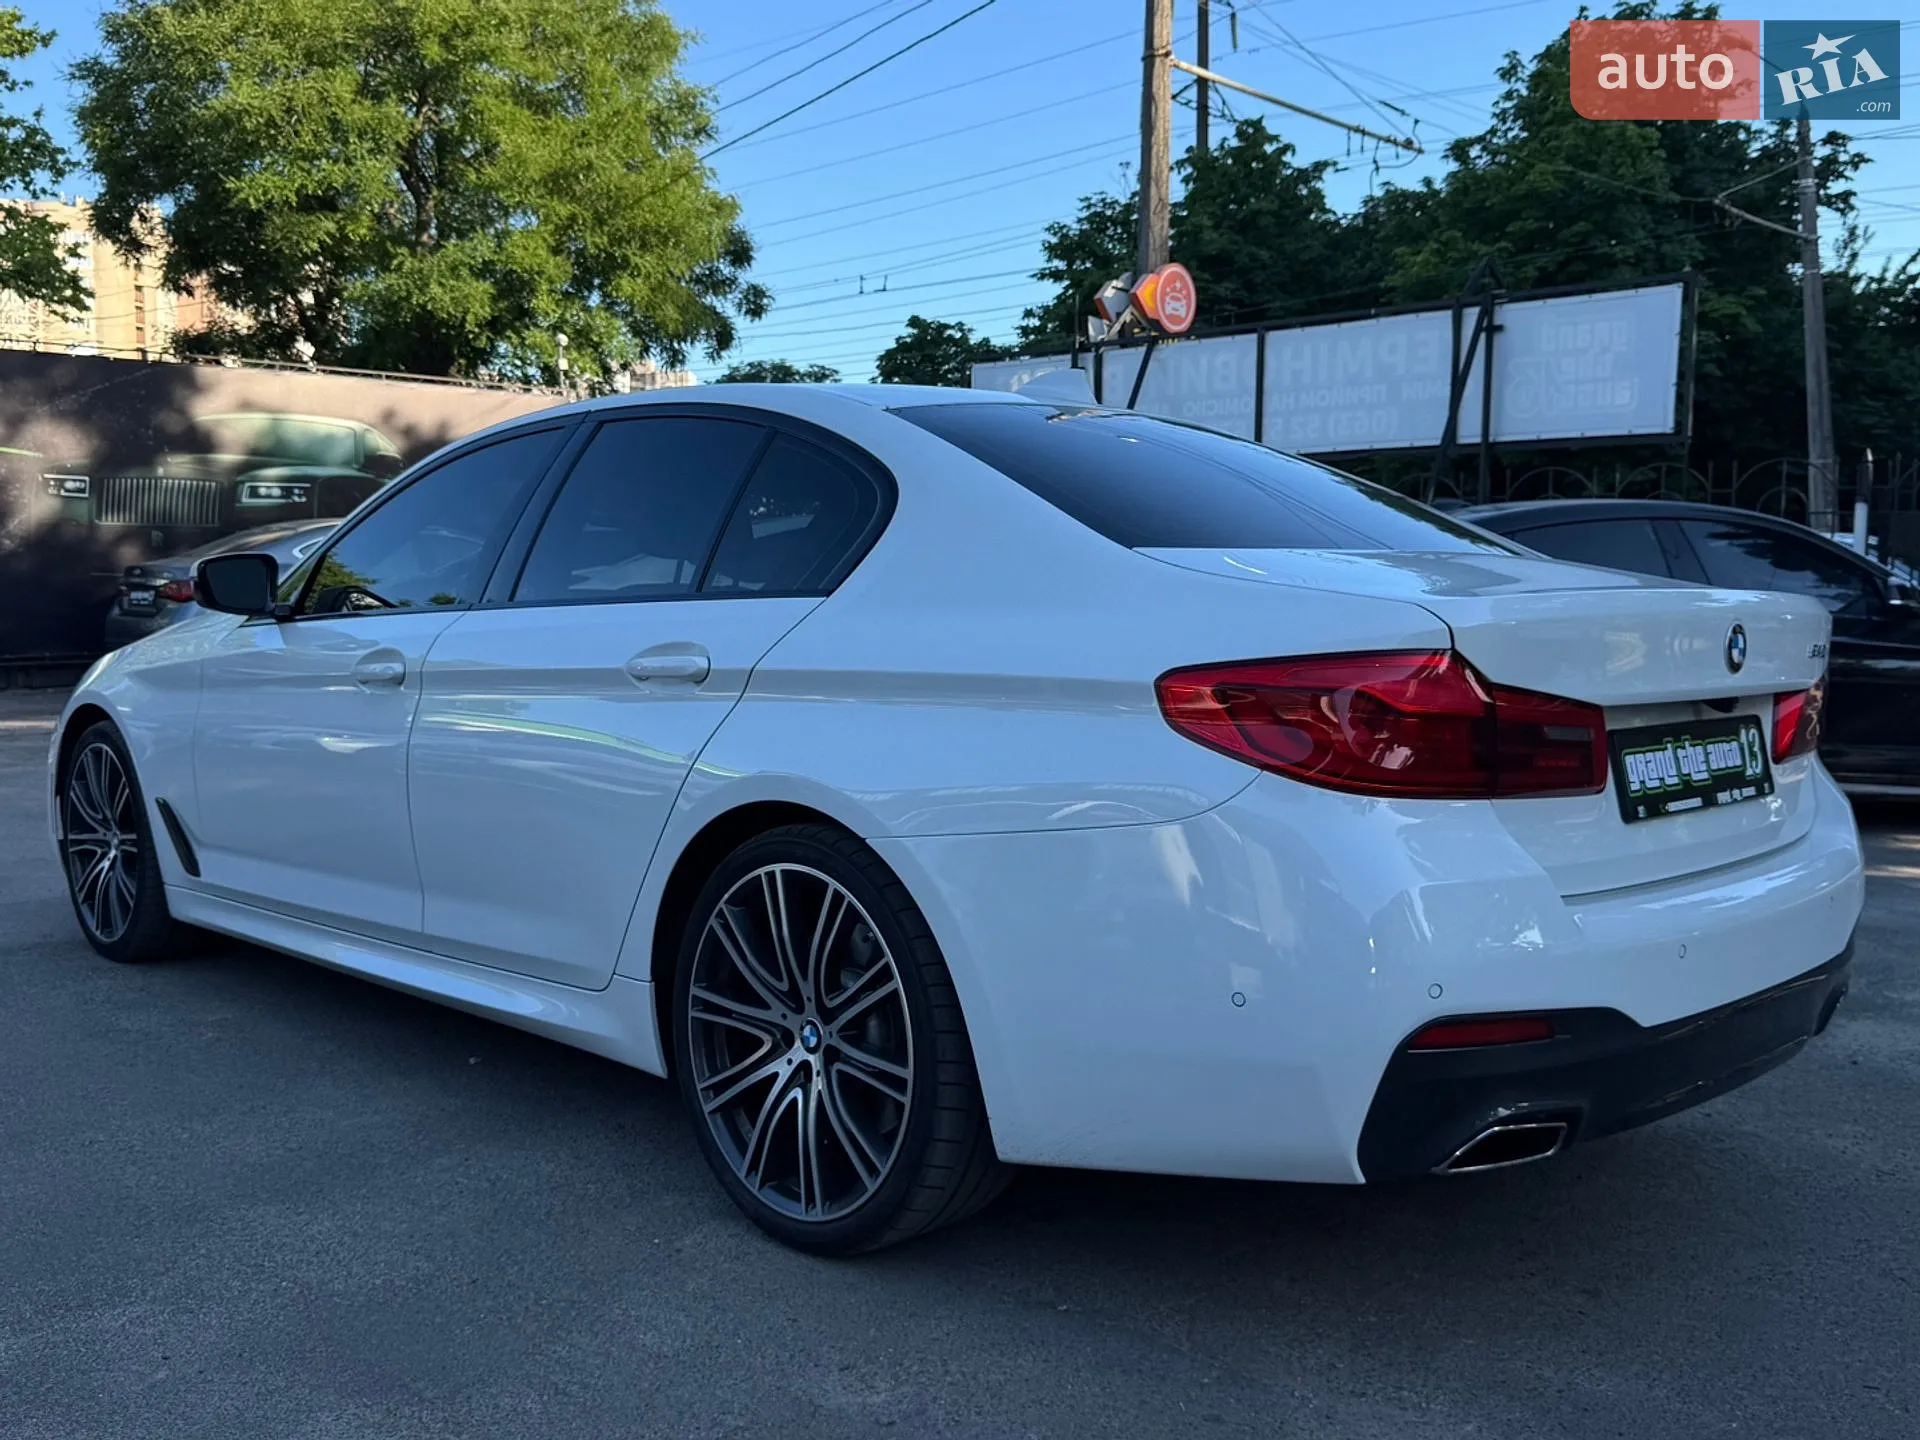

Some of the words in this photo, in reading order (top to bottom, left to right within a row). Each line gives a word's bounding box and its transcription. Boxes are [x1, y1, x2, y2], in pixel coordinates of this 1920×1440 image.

[1624, 743, 1681, 791] grand
[1676, 739, 1710, 781] the
[1707, 739, 1743, 770] auto
[1739, 726, 1762, 777] 13
